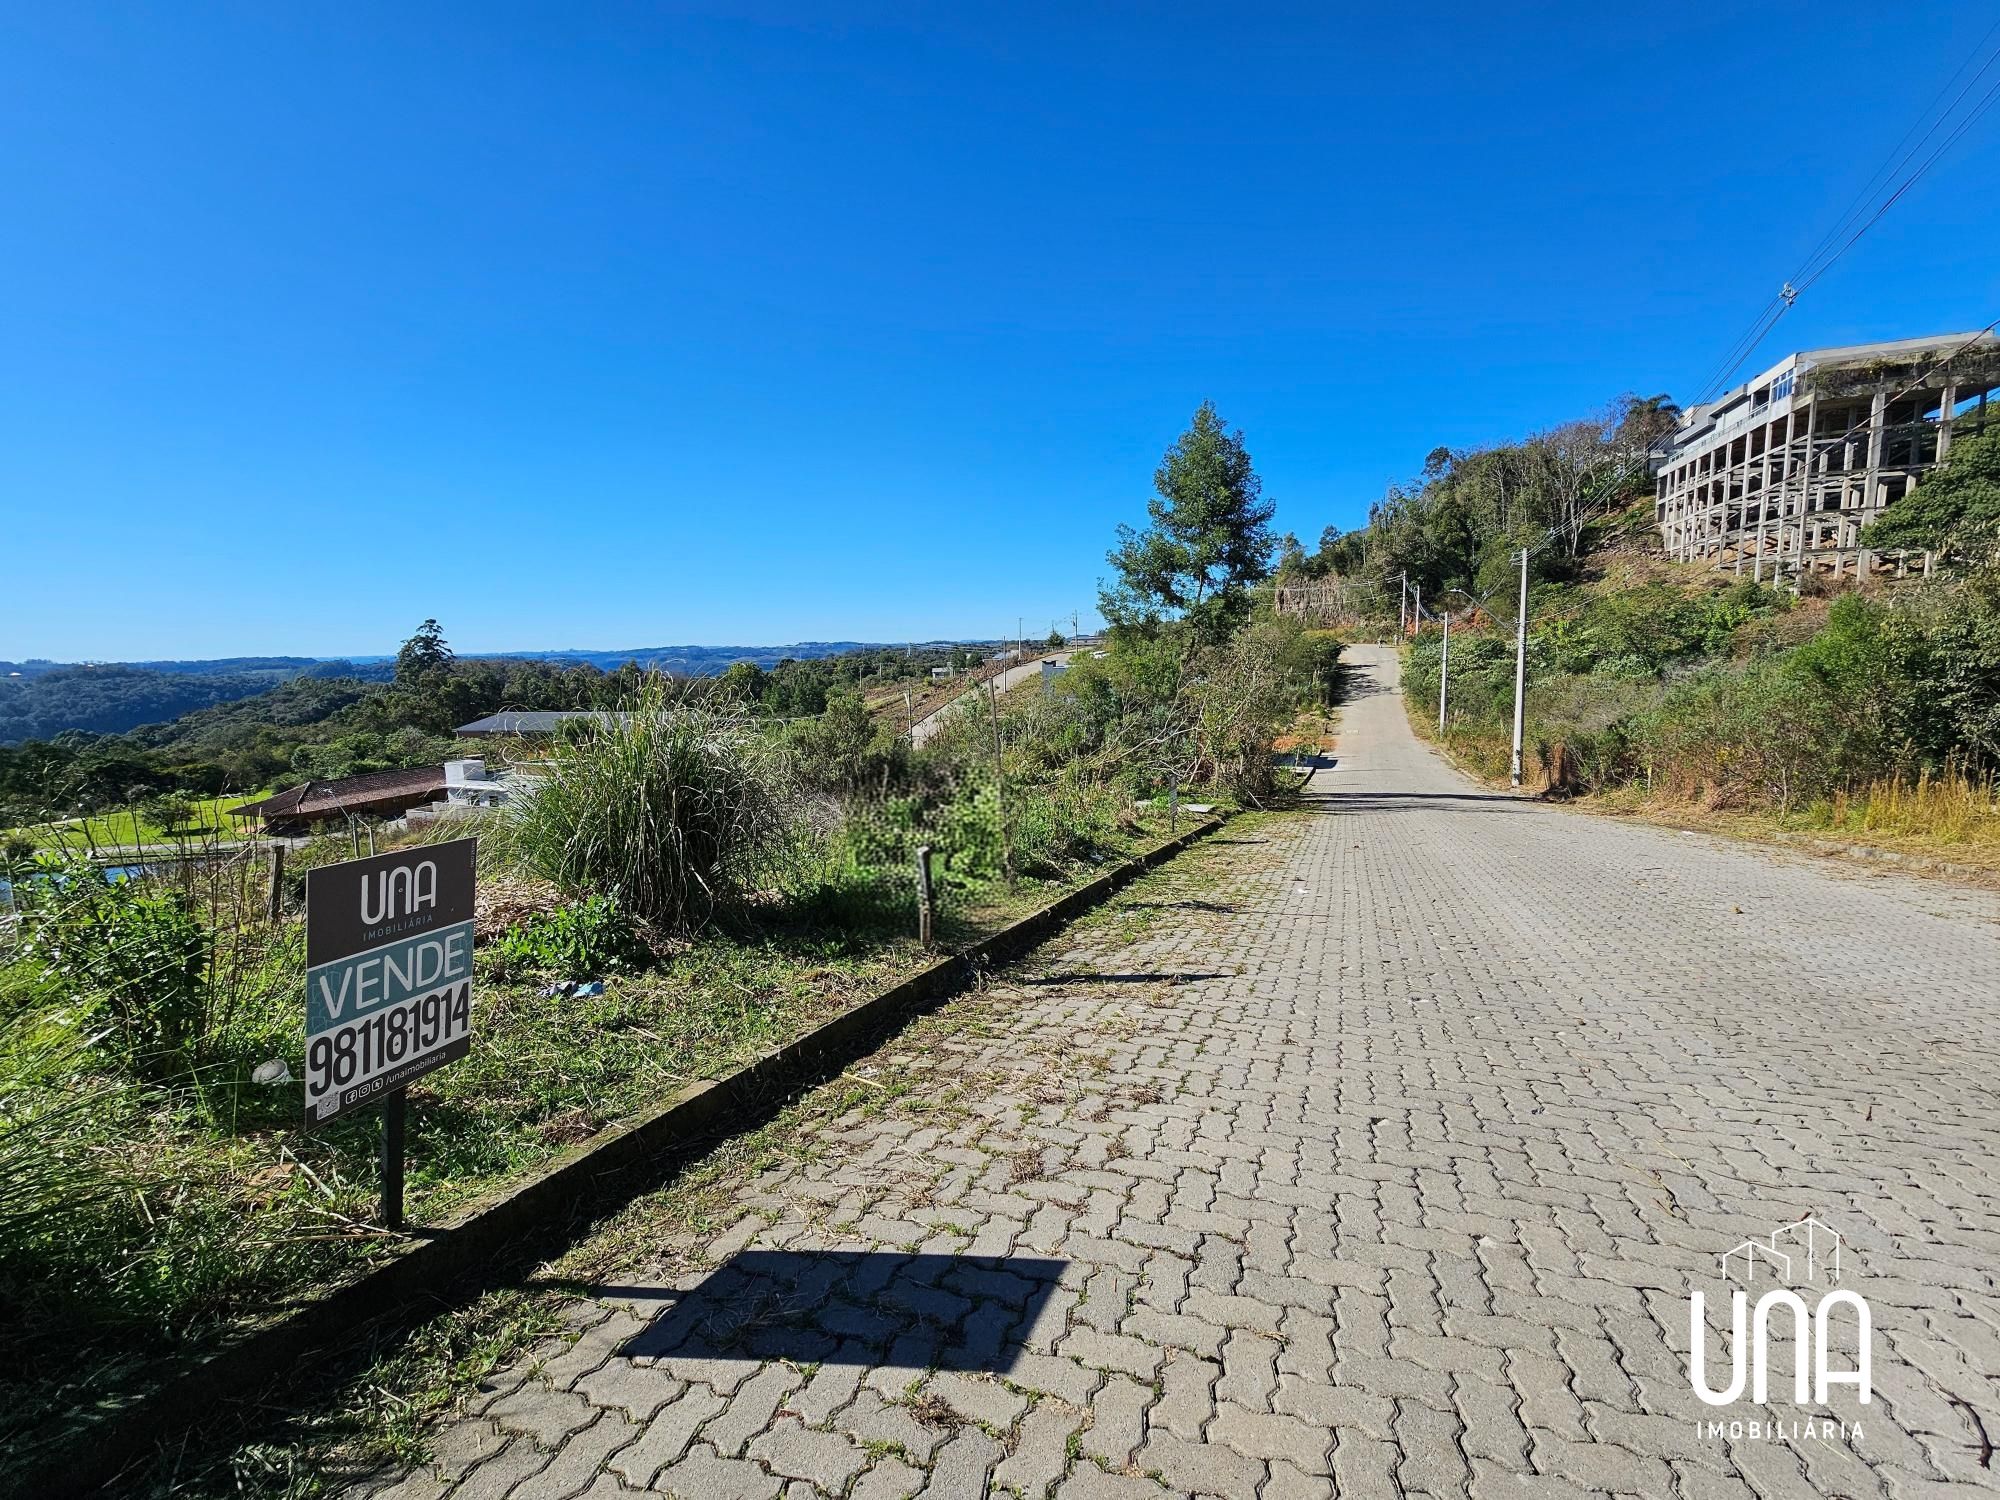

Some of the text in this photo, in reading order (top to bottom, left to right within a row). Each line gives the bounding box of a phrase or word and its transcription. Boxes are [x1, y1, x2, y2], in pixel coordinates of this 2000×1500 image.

[361, 860, 437, 925] UNA
[363, 914, 433, 942] IMOBILIÁRIA
[319, 931, 466, 1020] VENDE
